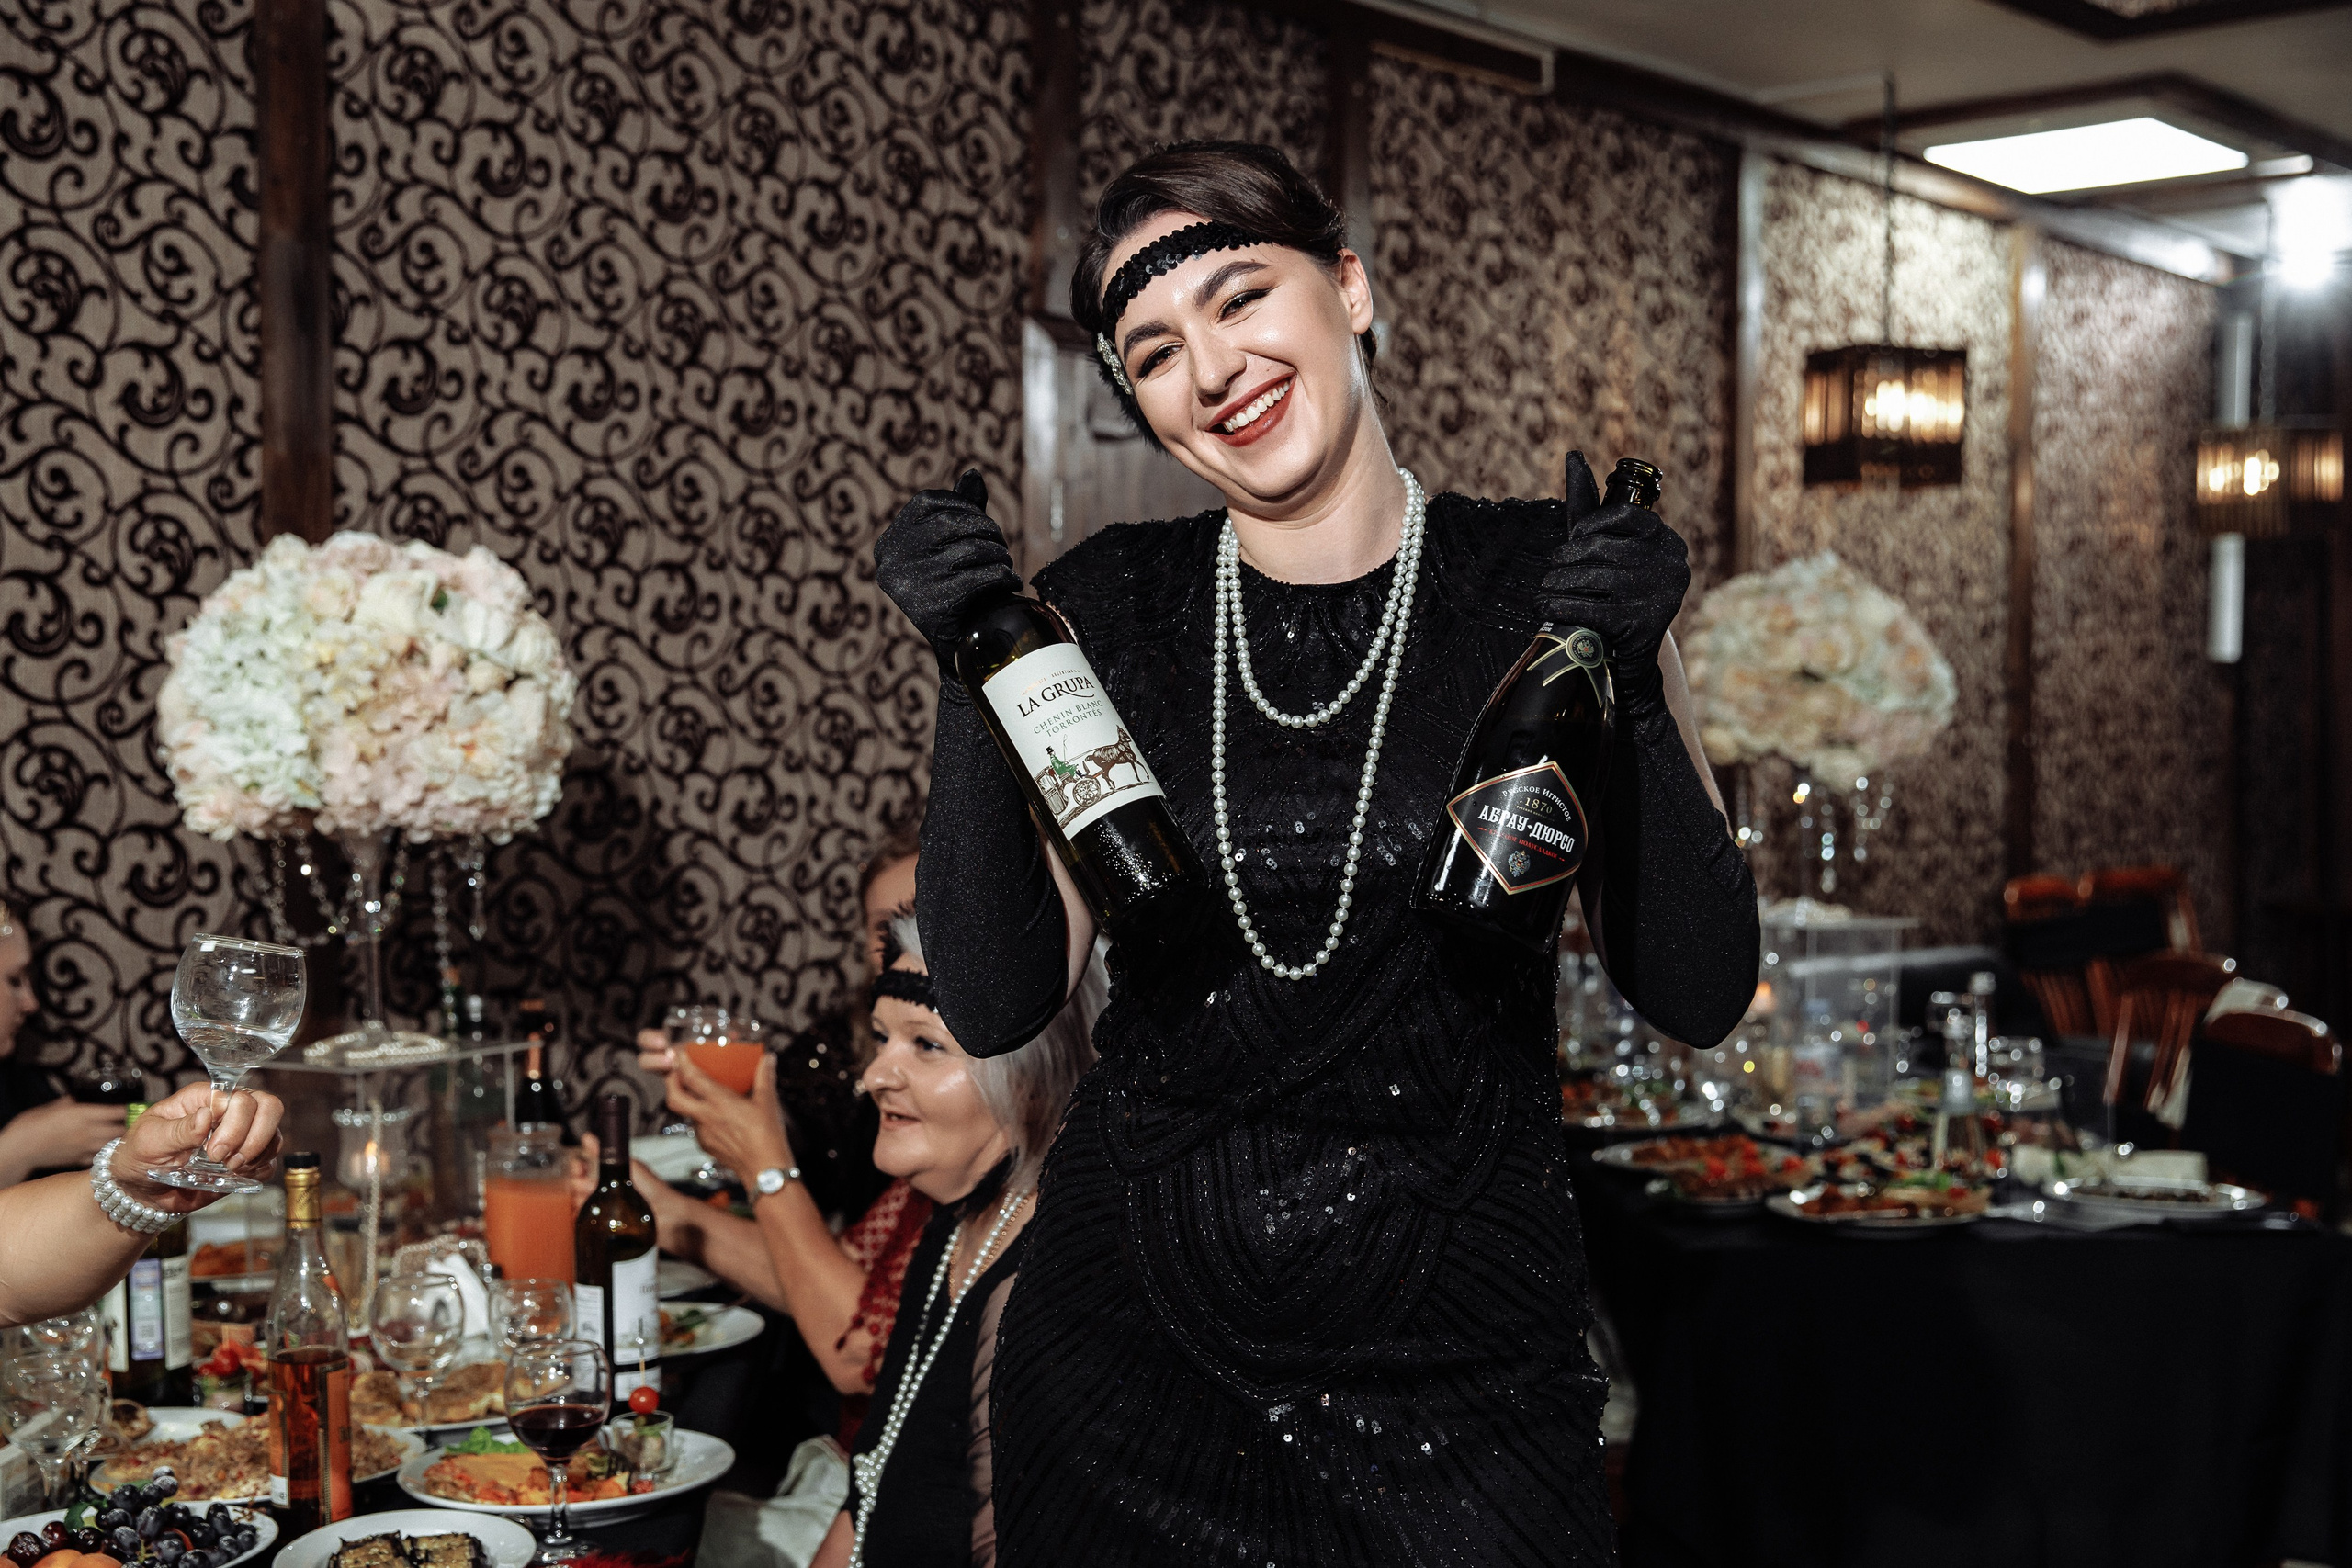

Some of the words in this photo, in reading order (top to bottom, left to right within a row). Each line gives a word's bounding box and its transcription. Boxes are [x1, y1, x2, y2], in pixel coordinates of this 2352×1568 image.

[1017, 697, 1040, 717] LA
[1041, 676, 1095, 702] GRUPA
[1034, 708, 1073, 734] CHENIN
[1075, 699, 1103, 712] BLANC
[1524, 797, 1553, 814] 1870
[1542, 788, 1572, 822] ИГРИСТОЕ
[1477, 804, 1576, 853] АБРАУ-ДЮРСО
